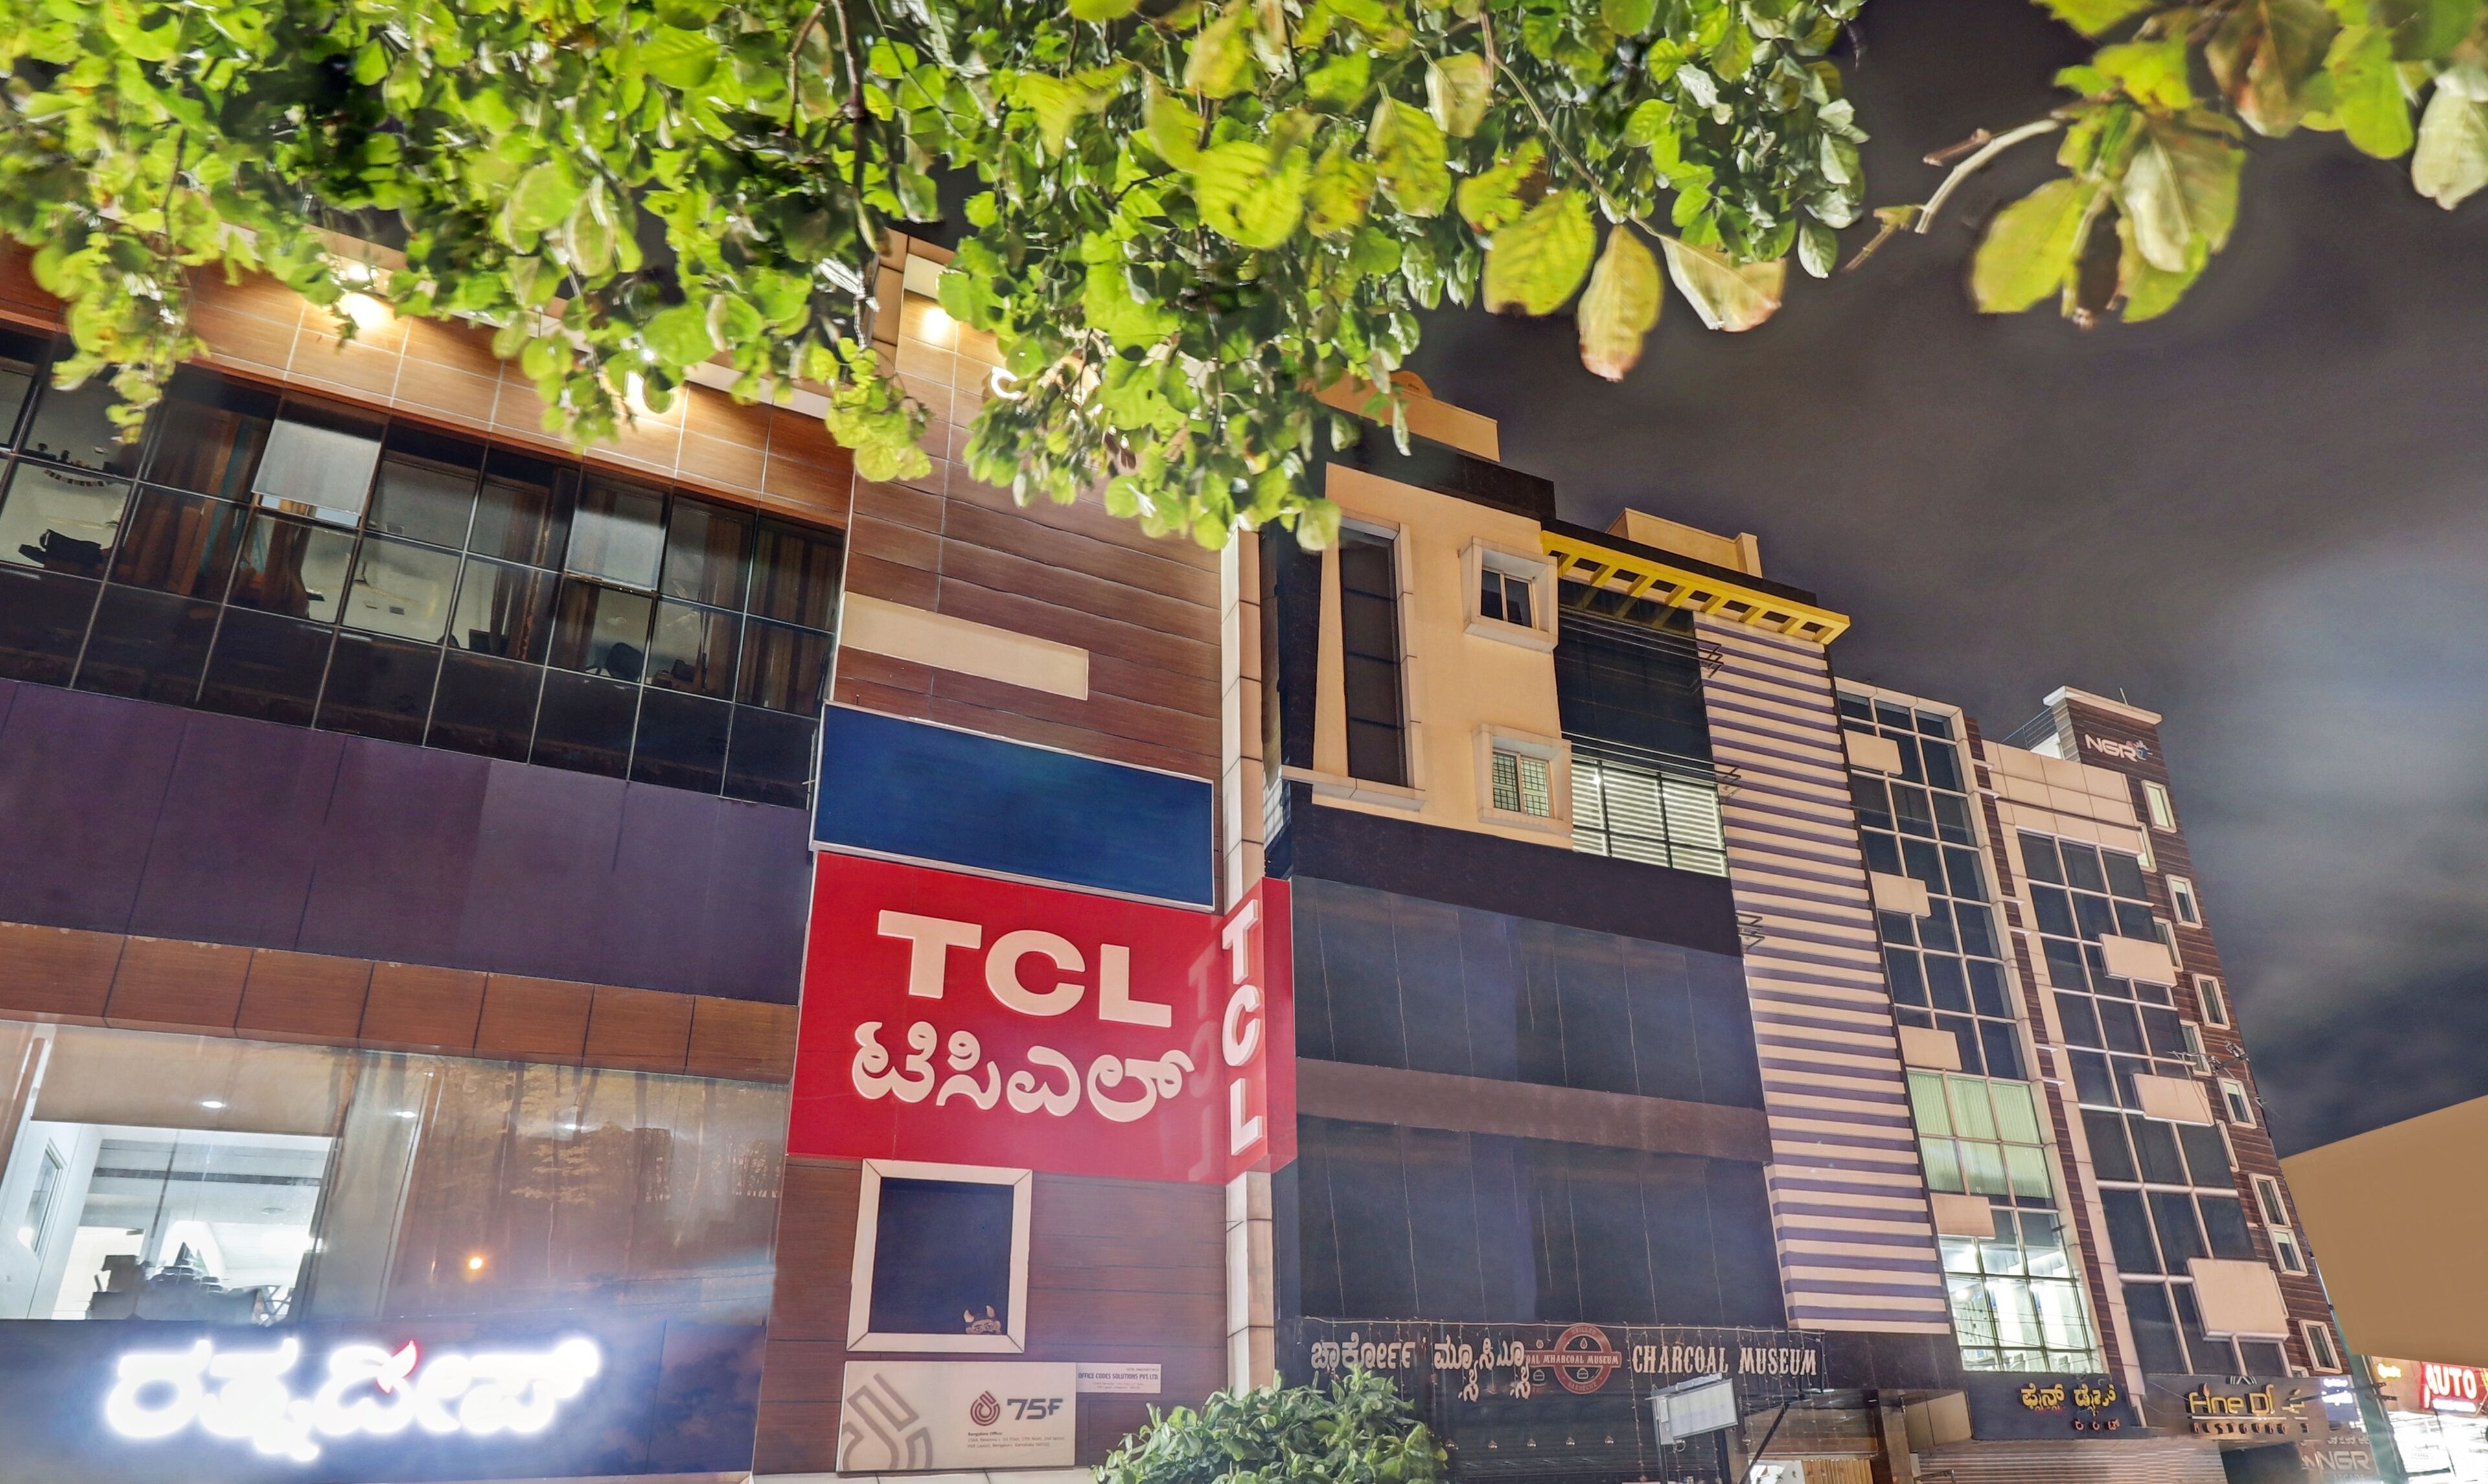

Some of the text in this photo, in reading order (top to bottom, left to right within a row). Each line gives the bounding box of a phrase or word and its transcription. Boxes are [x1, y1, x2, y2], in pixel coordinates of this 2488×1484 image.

[2084, 734, 2137, 762] NGR
[877, 909, 1171, 1027] TCL
[1221, 898, 1263, 1156] TCL
[852, 1021, 1195, 1123] ಟಿಸಿಎಲ್
[1587, 1356, 1618, 1364] MUSEUM
[1631, 1345, 1817, 1375] CHARCOAL MUSEUM
[2425, 1364, 2477, 1408] AUTO
[1007, 1398, 1063, 1420] 75F
[2316, 1451, 2370, 1470] NGR
